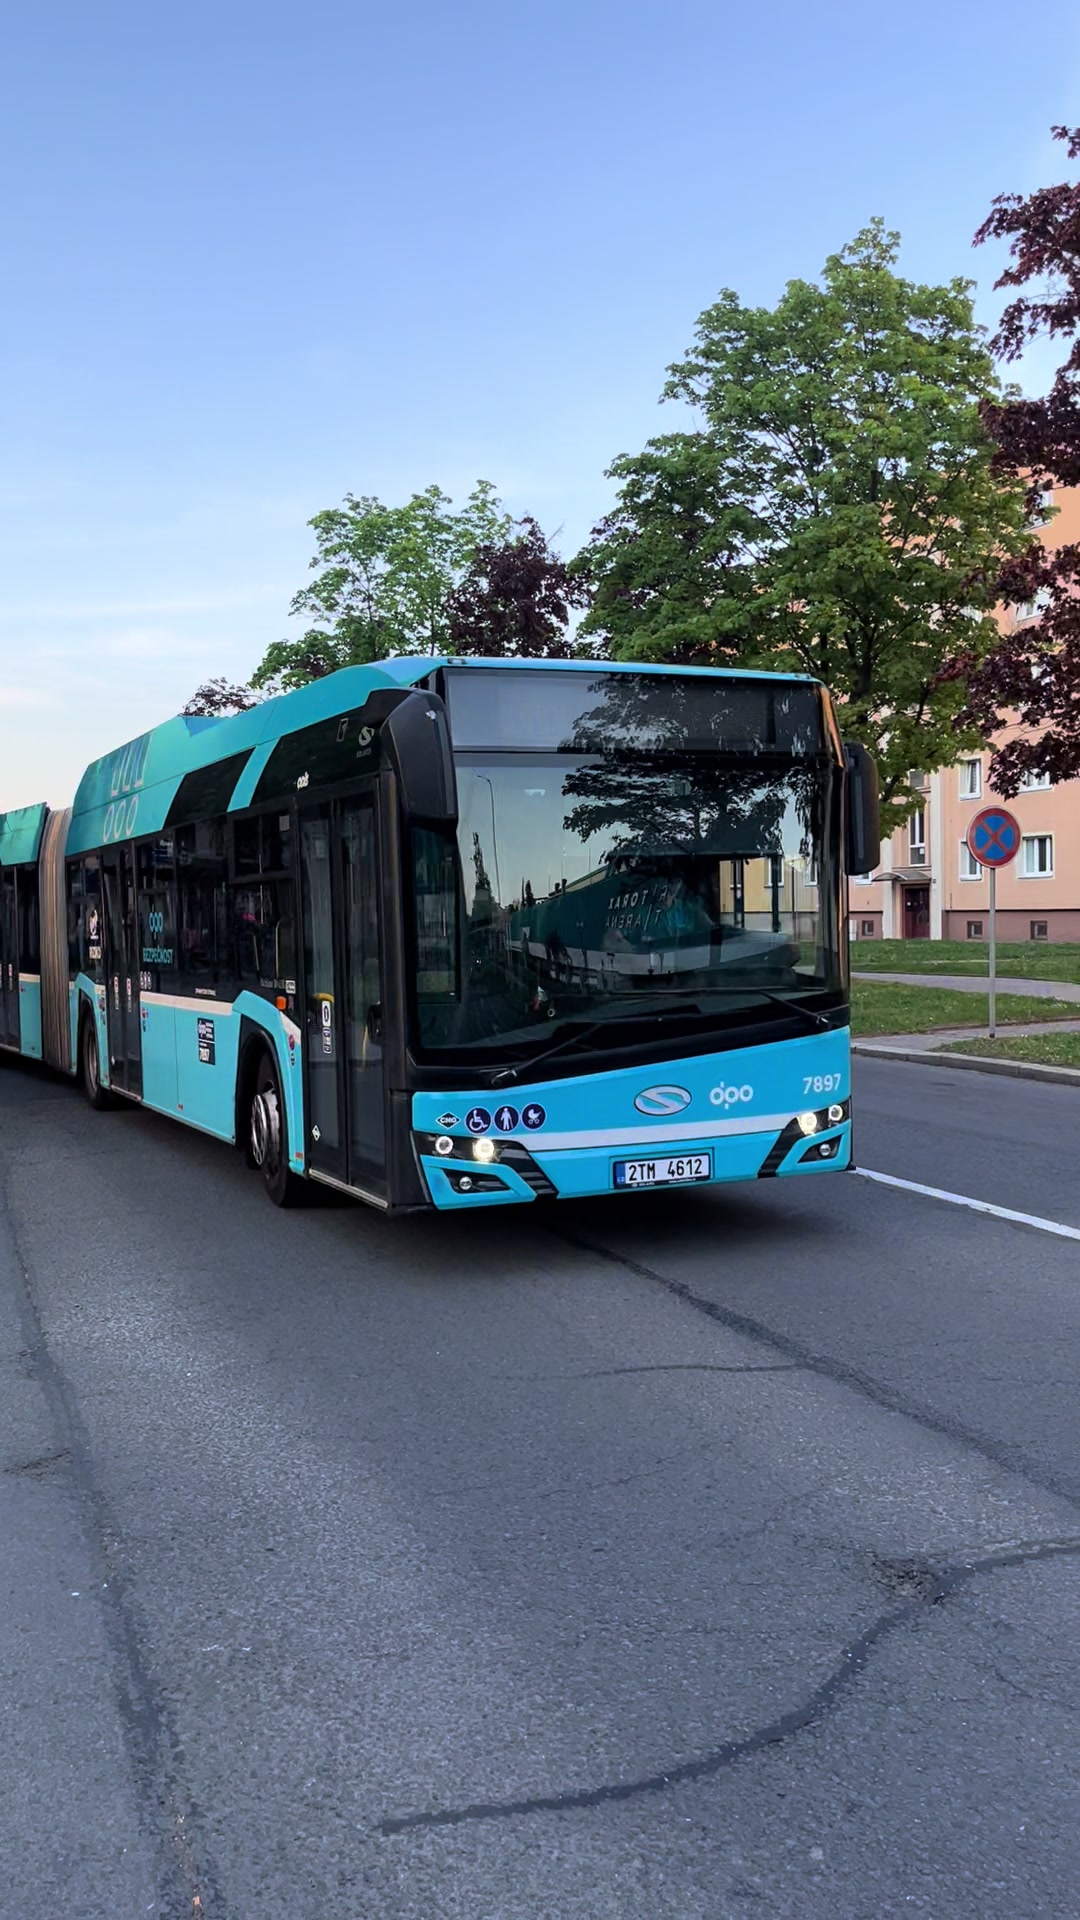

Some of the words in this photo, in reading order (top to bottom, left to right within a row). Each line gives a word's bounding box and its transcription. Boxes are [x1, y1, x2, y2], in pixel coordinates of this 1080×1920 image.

[802, 1073, 842, 1095] 7897
[628, 1162, 656, 1181] 2TM
[667, 1158, 703, 1178] 4612
